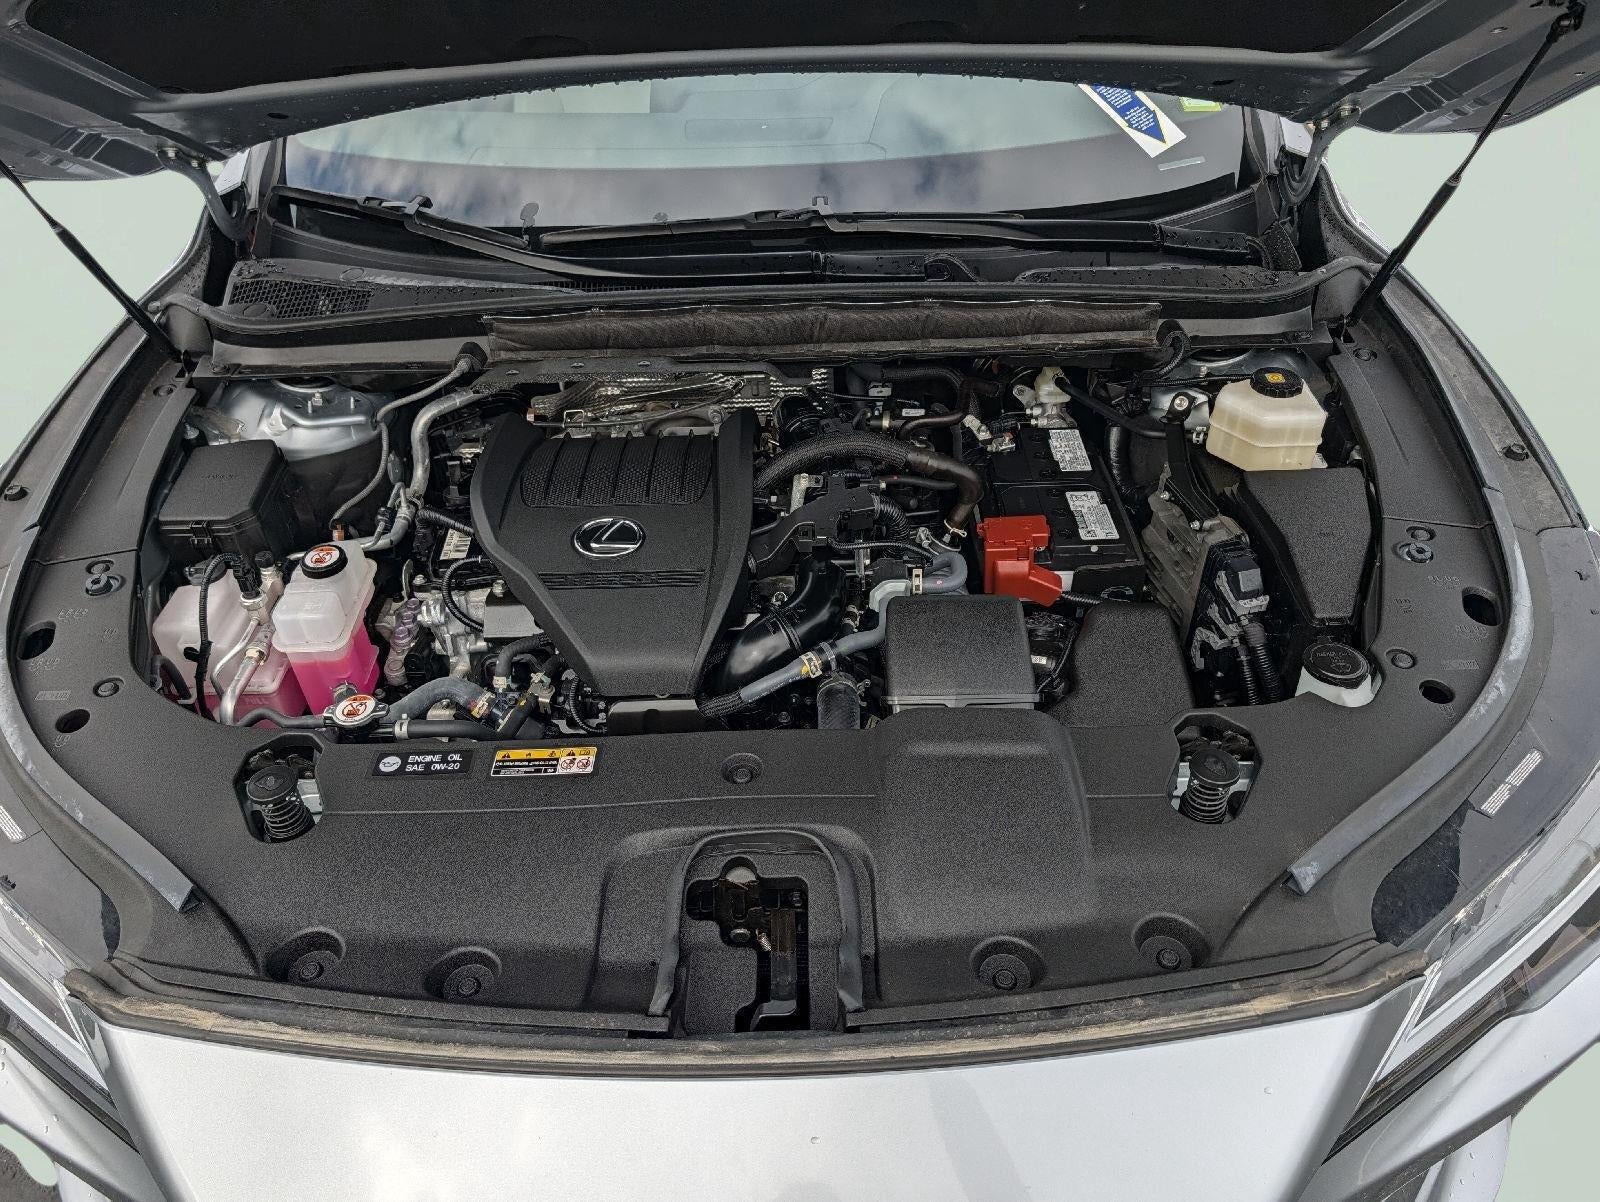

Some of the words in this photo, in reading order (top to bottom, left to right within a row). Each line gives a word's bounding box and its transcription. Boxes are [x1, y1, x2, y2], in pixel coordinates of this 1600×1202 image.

[407, 754, 443, 763] ENGINE
[447, 753, 463, 761] OIL
[405, 763, 425, 772] SAE
[430, 762, 460, 770] 0W-20
